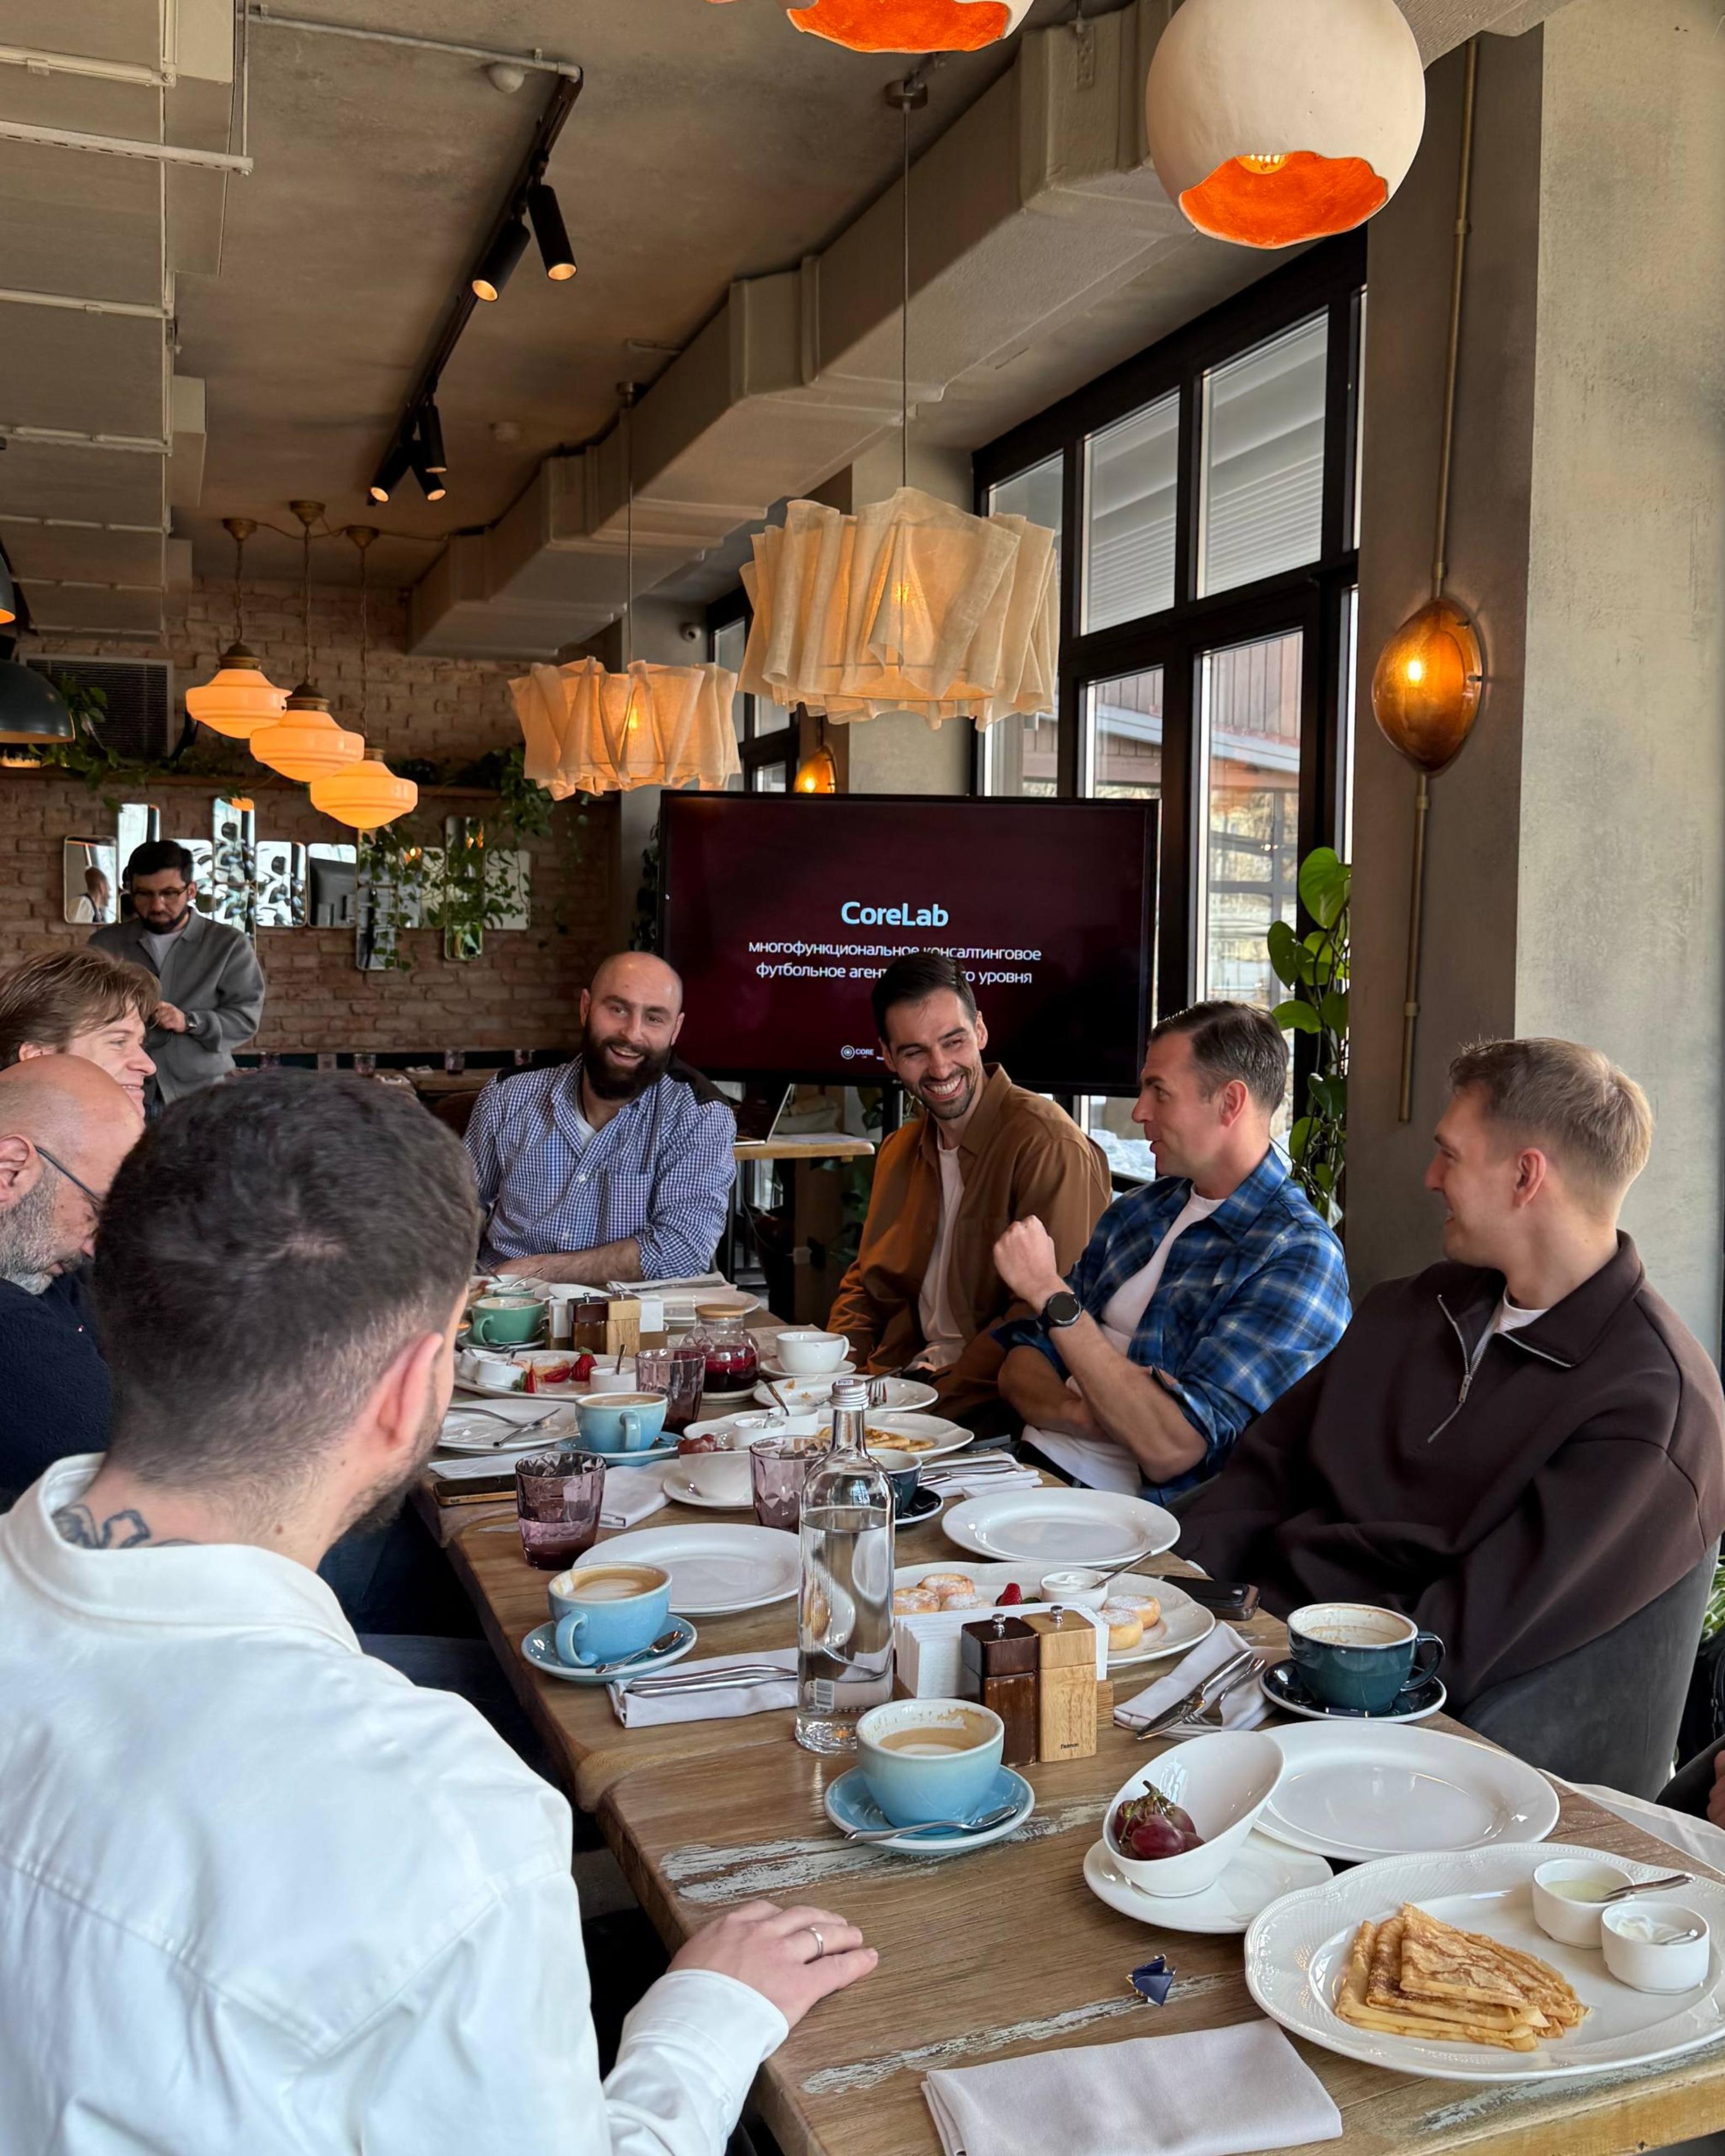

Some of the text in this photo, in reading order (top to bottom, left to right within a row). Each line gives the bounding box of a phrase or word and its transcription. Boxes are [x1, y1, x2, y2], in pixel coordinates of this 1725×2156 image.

[841, 901, 949, 927] CoreLab
[756, 962, 846, 978] футбольное
[978, 972, 1032, 985] уровня
